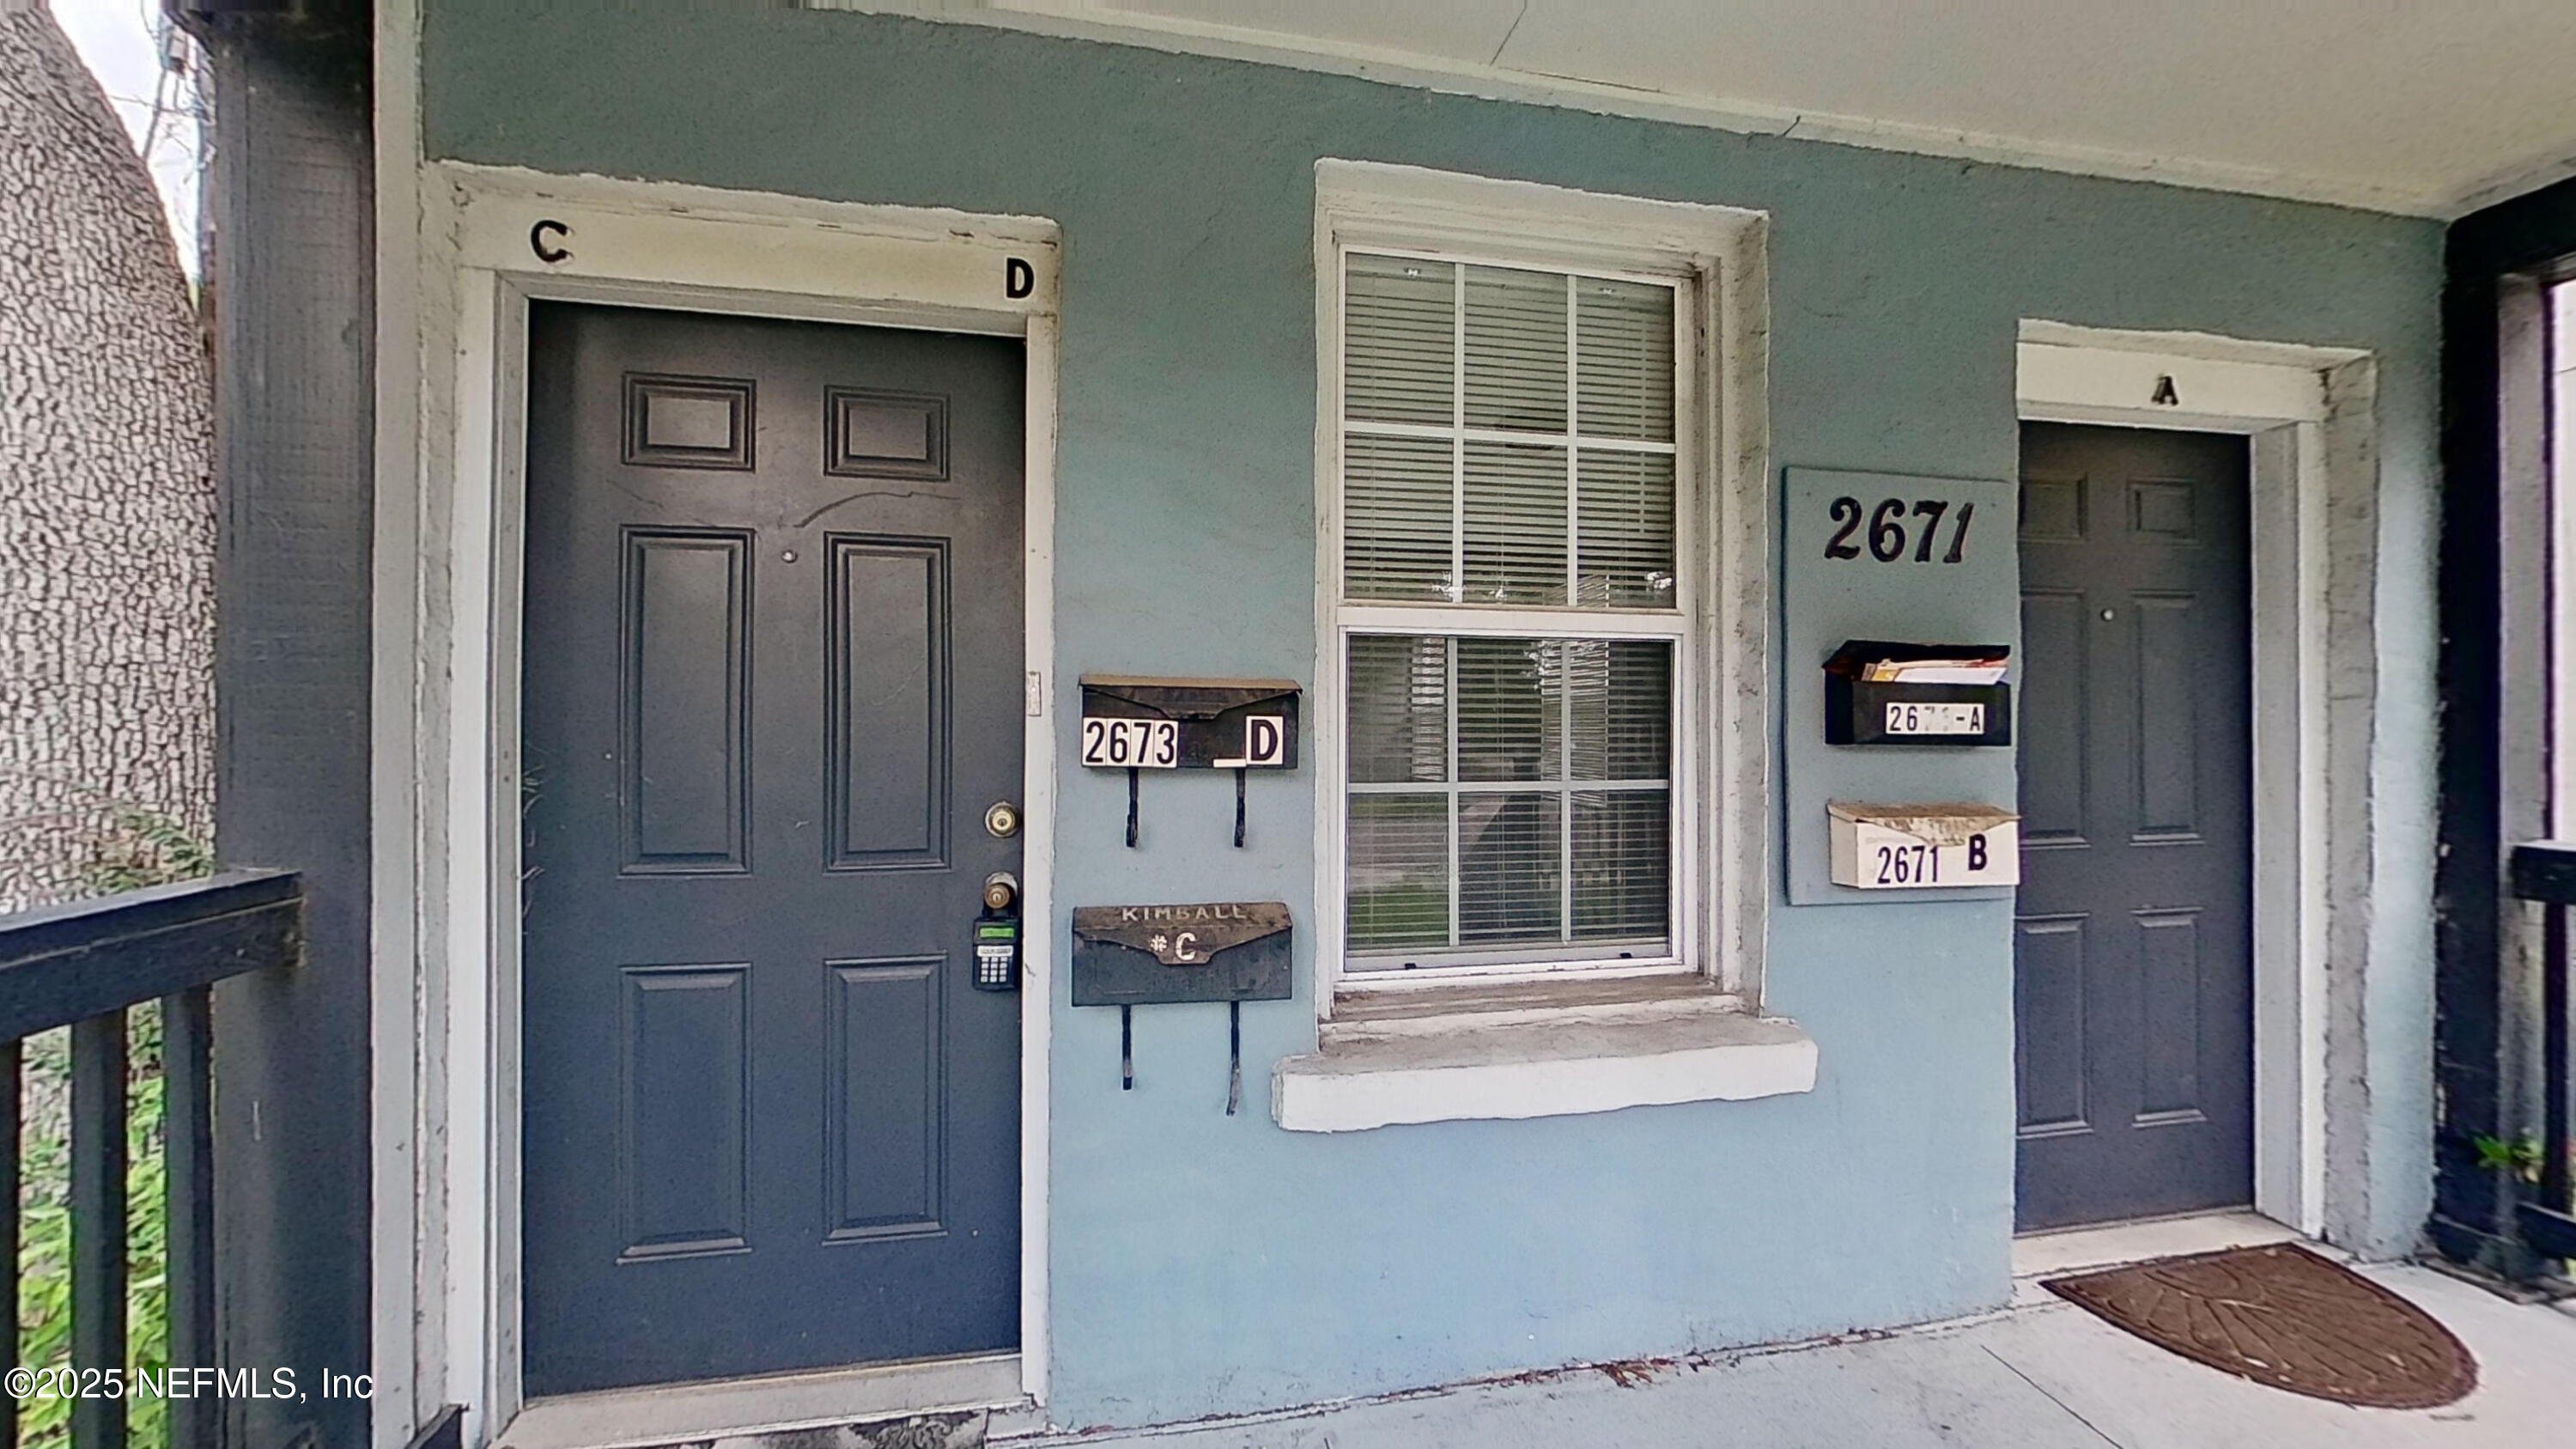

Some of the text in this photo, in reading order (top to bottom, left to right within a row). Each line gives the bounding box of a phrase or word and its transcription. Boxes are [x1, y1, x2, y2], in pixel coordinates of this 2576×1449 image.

[531, 220, 570, 263] C
[1006, 258, 1035, 299] D
[2151, 375, 2179, 406] A
[1824, 496, 1974, 563] 2671
[1085, 719, 1279, 764] 2673 D
[1877, 833, 1988, 884] 2671 B
[1121, 904, 1246, 922] KIMBALL
